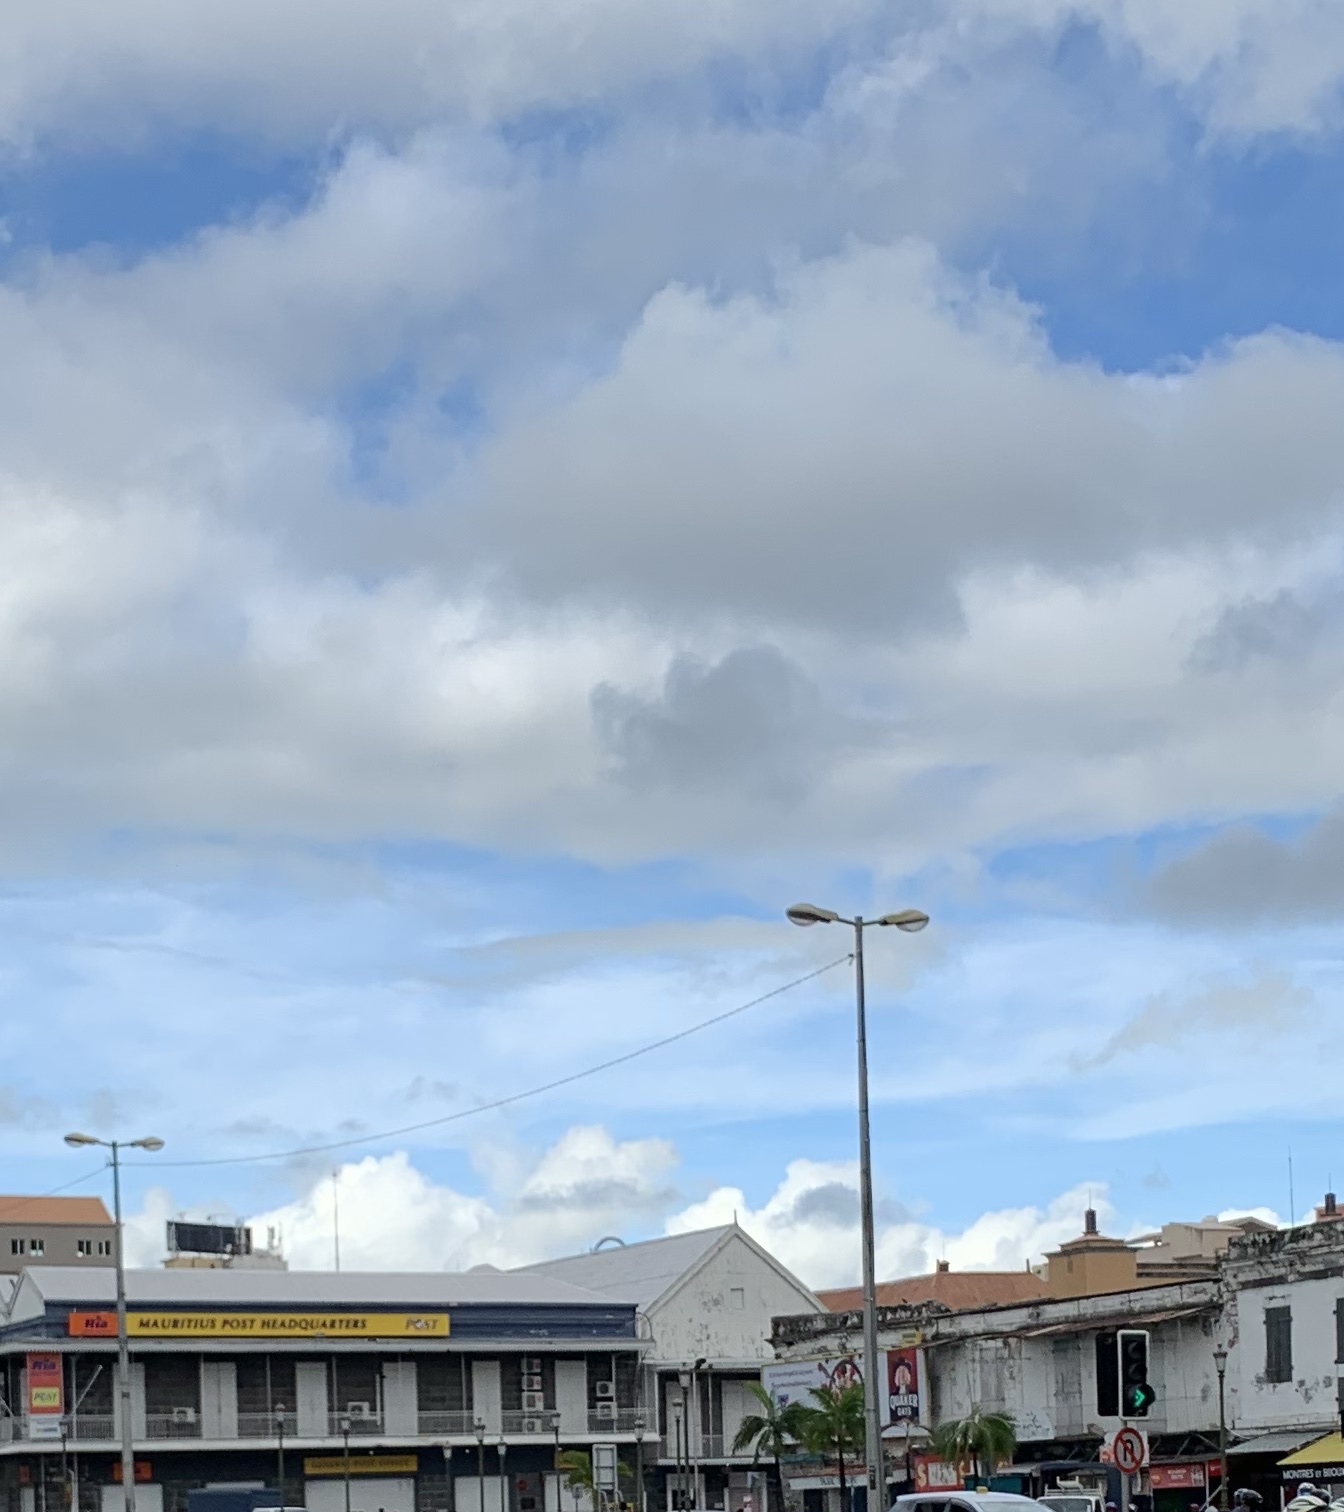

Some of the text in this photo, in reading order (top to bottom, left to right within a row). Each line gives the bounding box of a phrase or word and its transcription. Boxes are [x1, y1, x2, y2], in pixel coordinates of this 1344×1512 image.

[138, 1318, 367, 1331] MAURITIUS POST HEADQUARTERS
[889, 1393, 919, 1409] QUAKER
[1282, 1469, 1314, 1480] MONTRES
